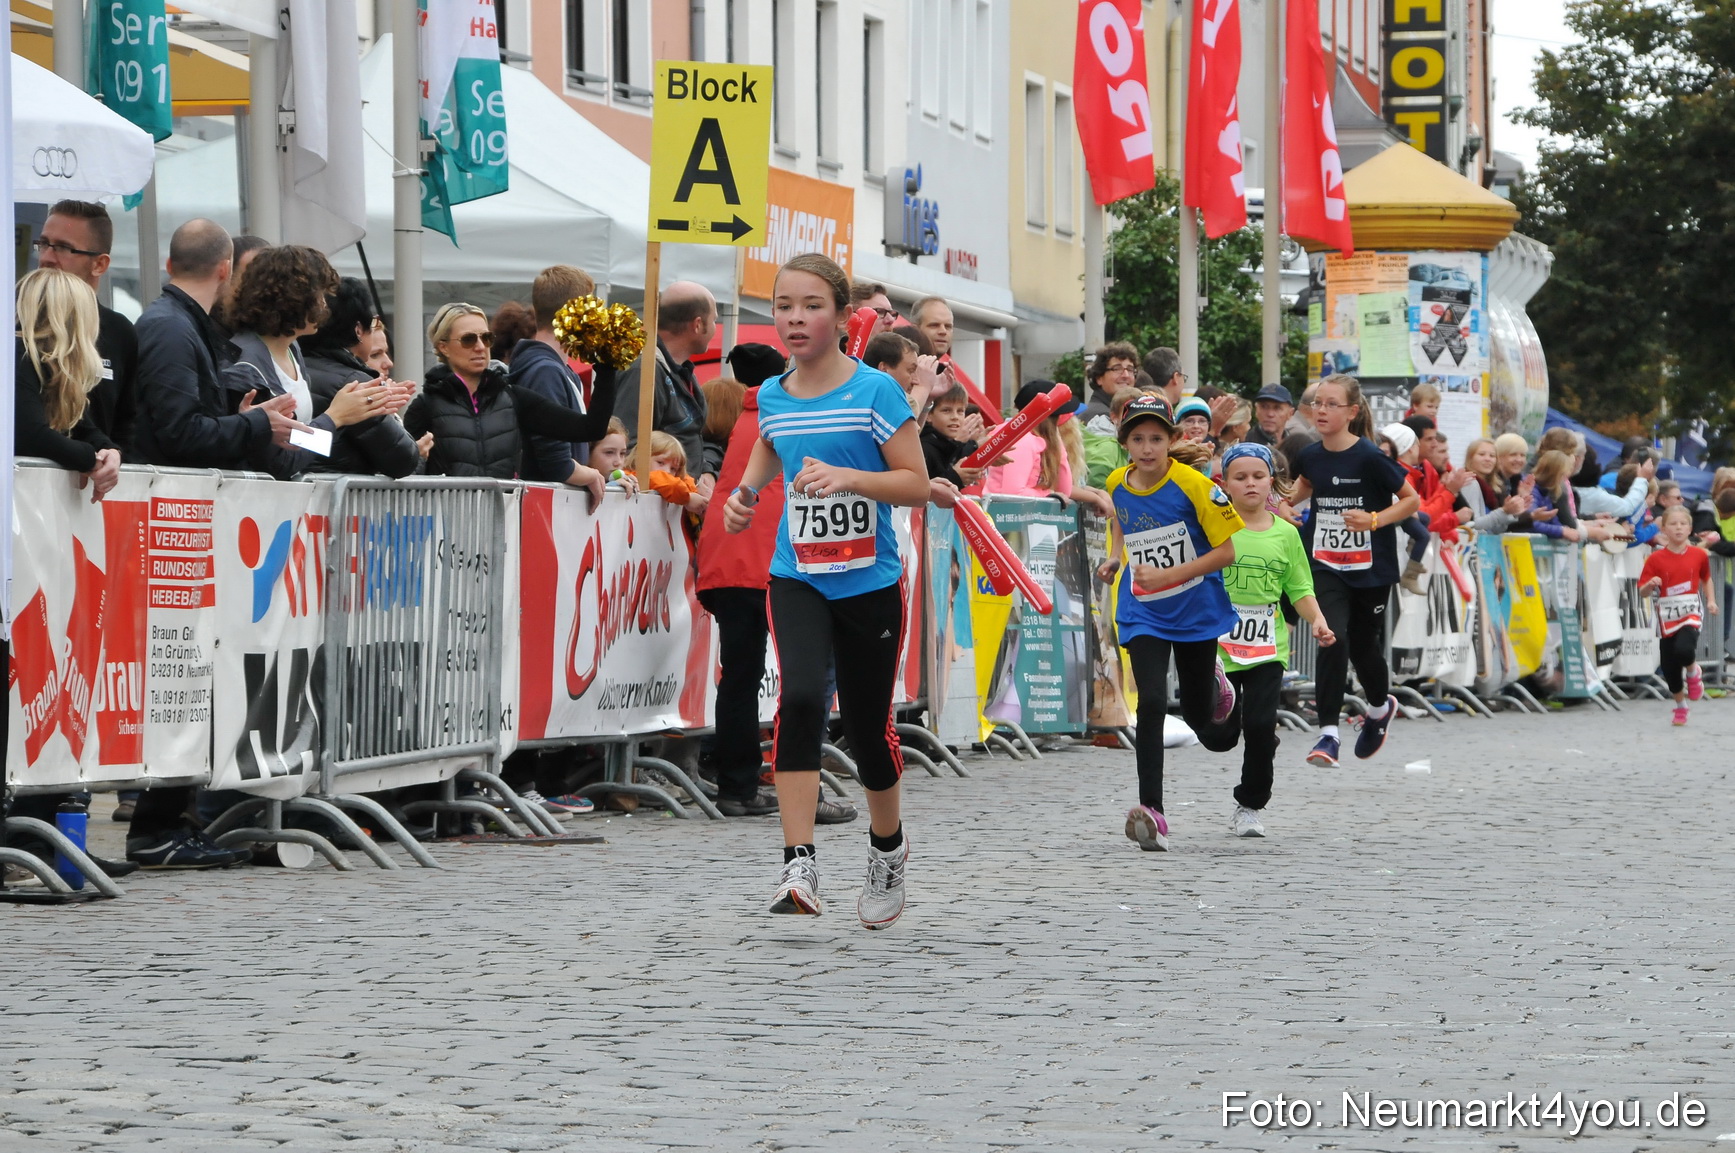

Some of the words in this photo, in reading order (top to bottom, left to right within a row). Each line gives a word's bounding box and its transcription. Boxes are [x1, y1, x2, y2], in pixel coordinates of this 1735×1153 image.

[667, 68, 757, 103] Block
[673, 117, 741, 206] A
[976, 445, 993, 461] Audi
[991, 430, 1008, 447] BKK
[794, 500, 870, 538] 7599
[963, 520, 978, 539] Audi
[974, 537, 988, 556] BKK
[1126, 539, 1143, 549] PARTL
[1143, 532, 1176, 546] Neumarkt
[1320, 527, 1366, 549] 7520
[1132, 539, 1186, 569] 7537
[152, 625, 178, 640] Braun
[151, 644, 163, 659] Am
[1232, 646, 1249, 657] Eva
[151, 663, 184, 678] D-92318
[23, 670, 58, 737] Braun
